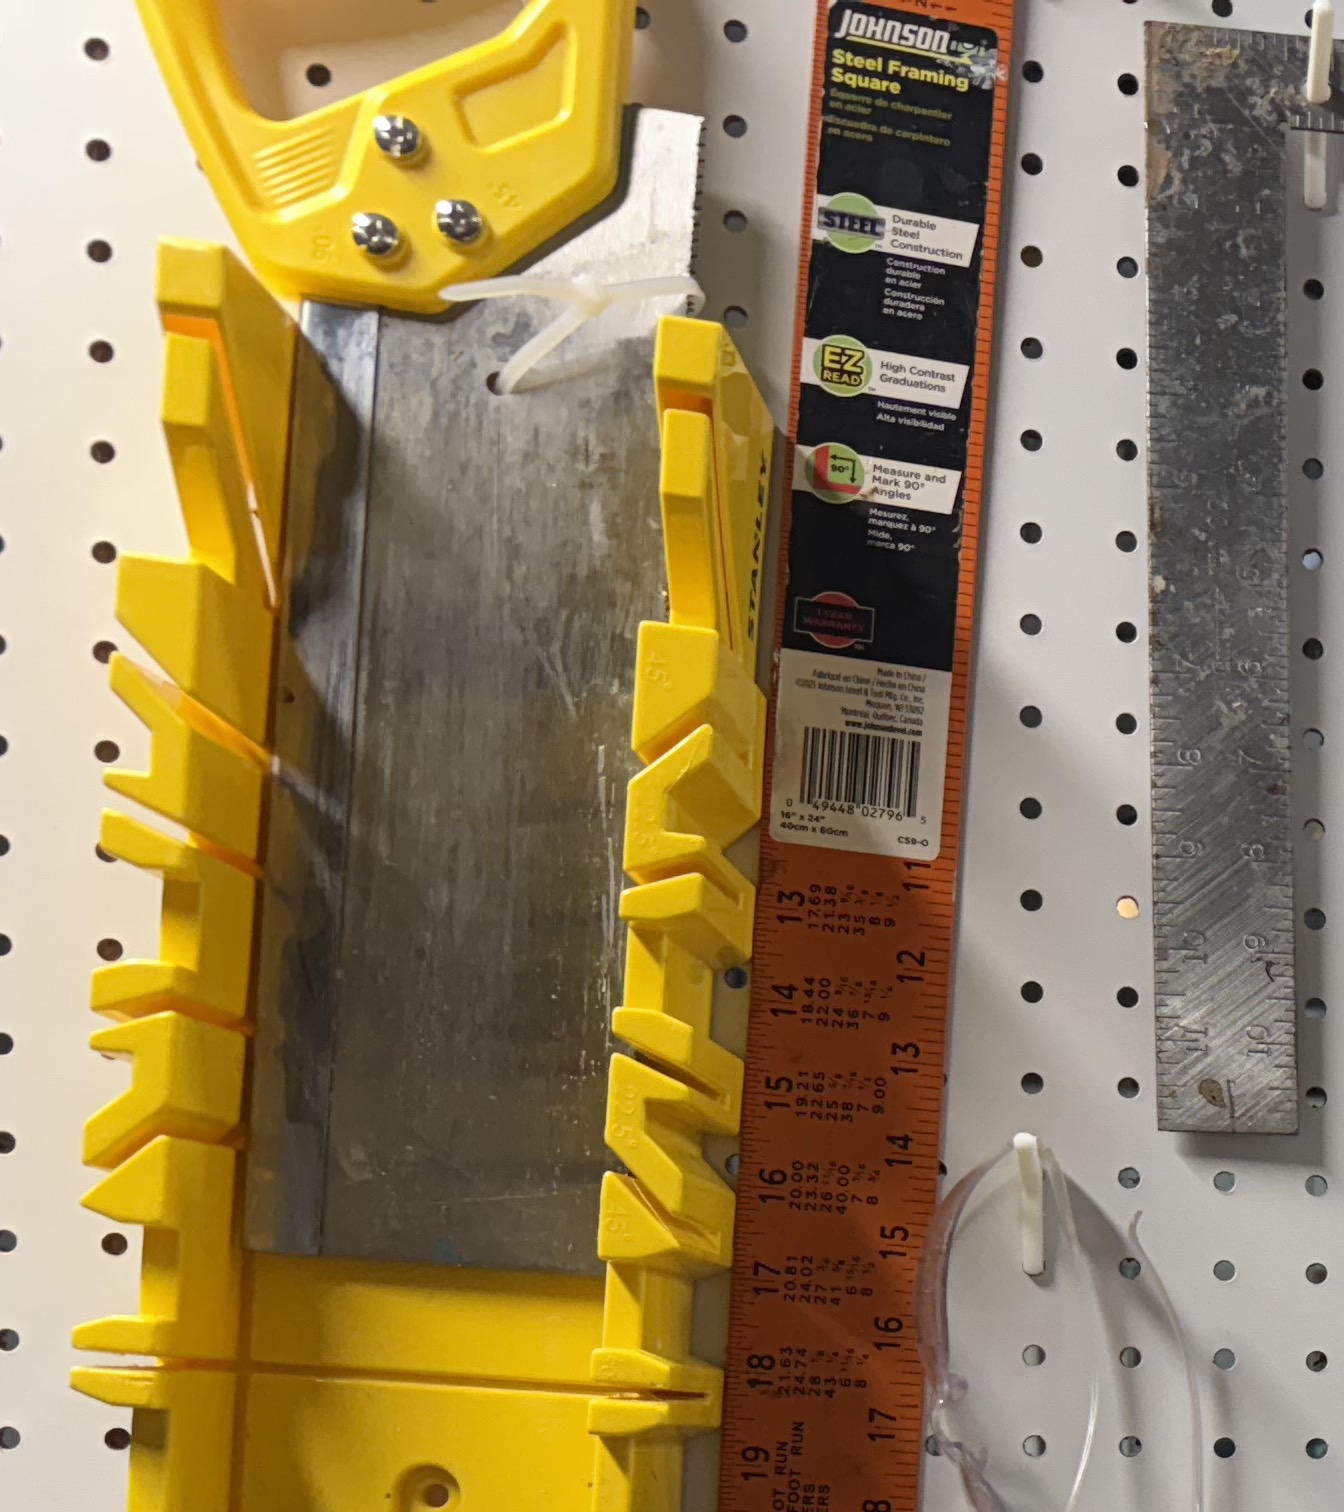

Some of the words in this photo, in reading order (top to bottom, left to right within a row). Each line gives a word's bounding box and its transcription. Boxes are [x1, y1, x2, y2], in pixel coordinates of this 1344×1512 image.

[834, 9, 950, 54] JOHNSON
[831, 48, 883, 72] Steel
[887, 59, 970, 92] Framing
[831, 67, 901, 94] Square
[824, 209, 881, 236] STEEL
[891, 226, 920, 240] Steel
[892, 214, 937, 231] Durable
[890, 239, 963, 261] Construction
[823, 346, 865, 374] EZ
[880, 361, 906, 374] High
[909, 366, 956, 382] Contrast
[823, 370, 862, 387] READ
[879, 373, 946, 393] Graduations
[872, 463, 921, 480] Measure
[924, 473, 947, 484] and
[872, 475, 901, 488] Mark
[872, 486, 912, 501] Angles
[786, 798, 793, 807] 0
[812, 800, 855, 815] 49448
[862, 806, 904, 822] 02796
[776, 890, 806, 925] 13
[896, 950, 926, 984] 12
[770, 983, 799, 1017] 14
[764, 1077, 793, 1110] 15
[884, 1134, 914, 1167] 14
[758, 1168, 788, 1203] 16
[879, 1225, 909, 1259] 15
[752, 1261, 781, 1296] 17
[873, 1316, 903, 1351] 16
[747, 1354, 776, 1388] 18
[791, 1421, 805, 1455] RUN
[867, 1408, 897, 1442] 17
[740, 1446, 770, 1482] 19
[775, 1441, 789, 1475] RUN
[787, 1469, 801, 1512] FOOT
